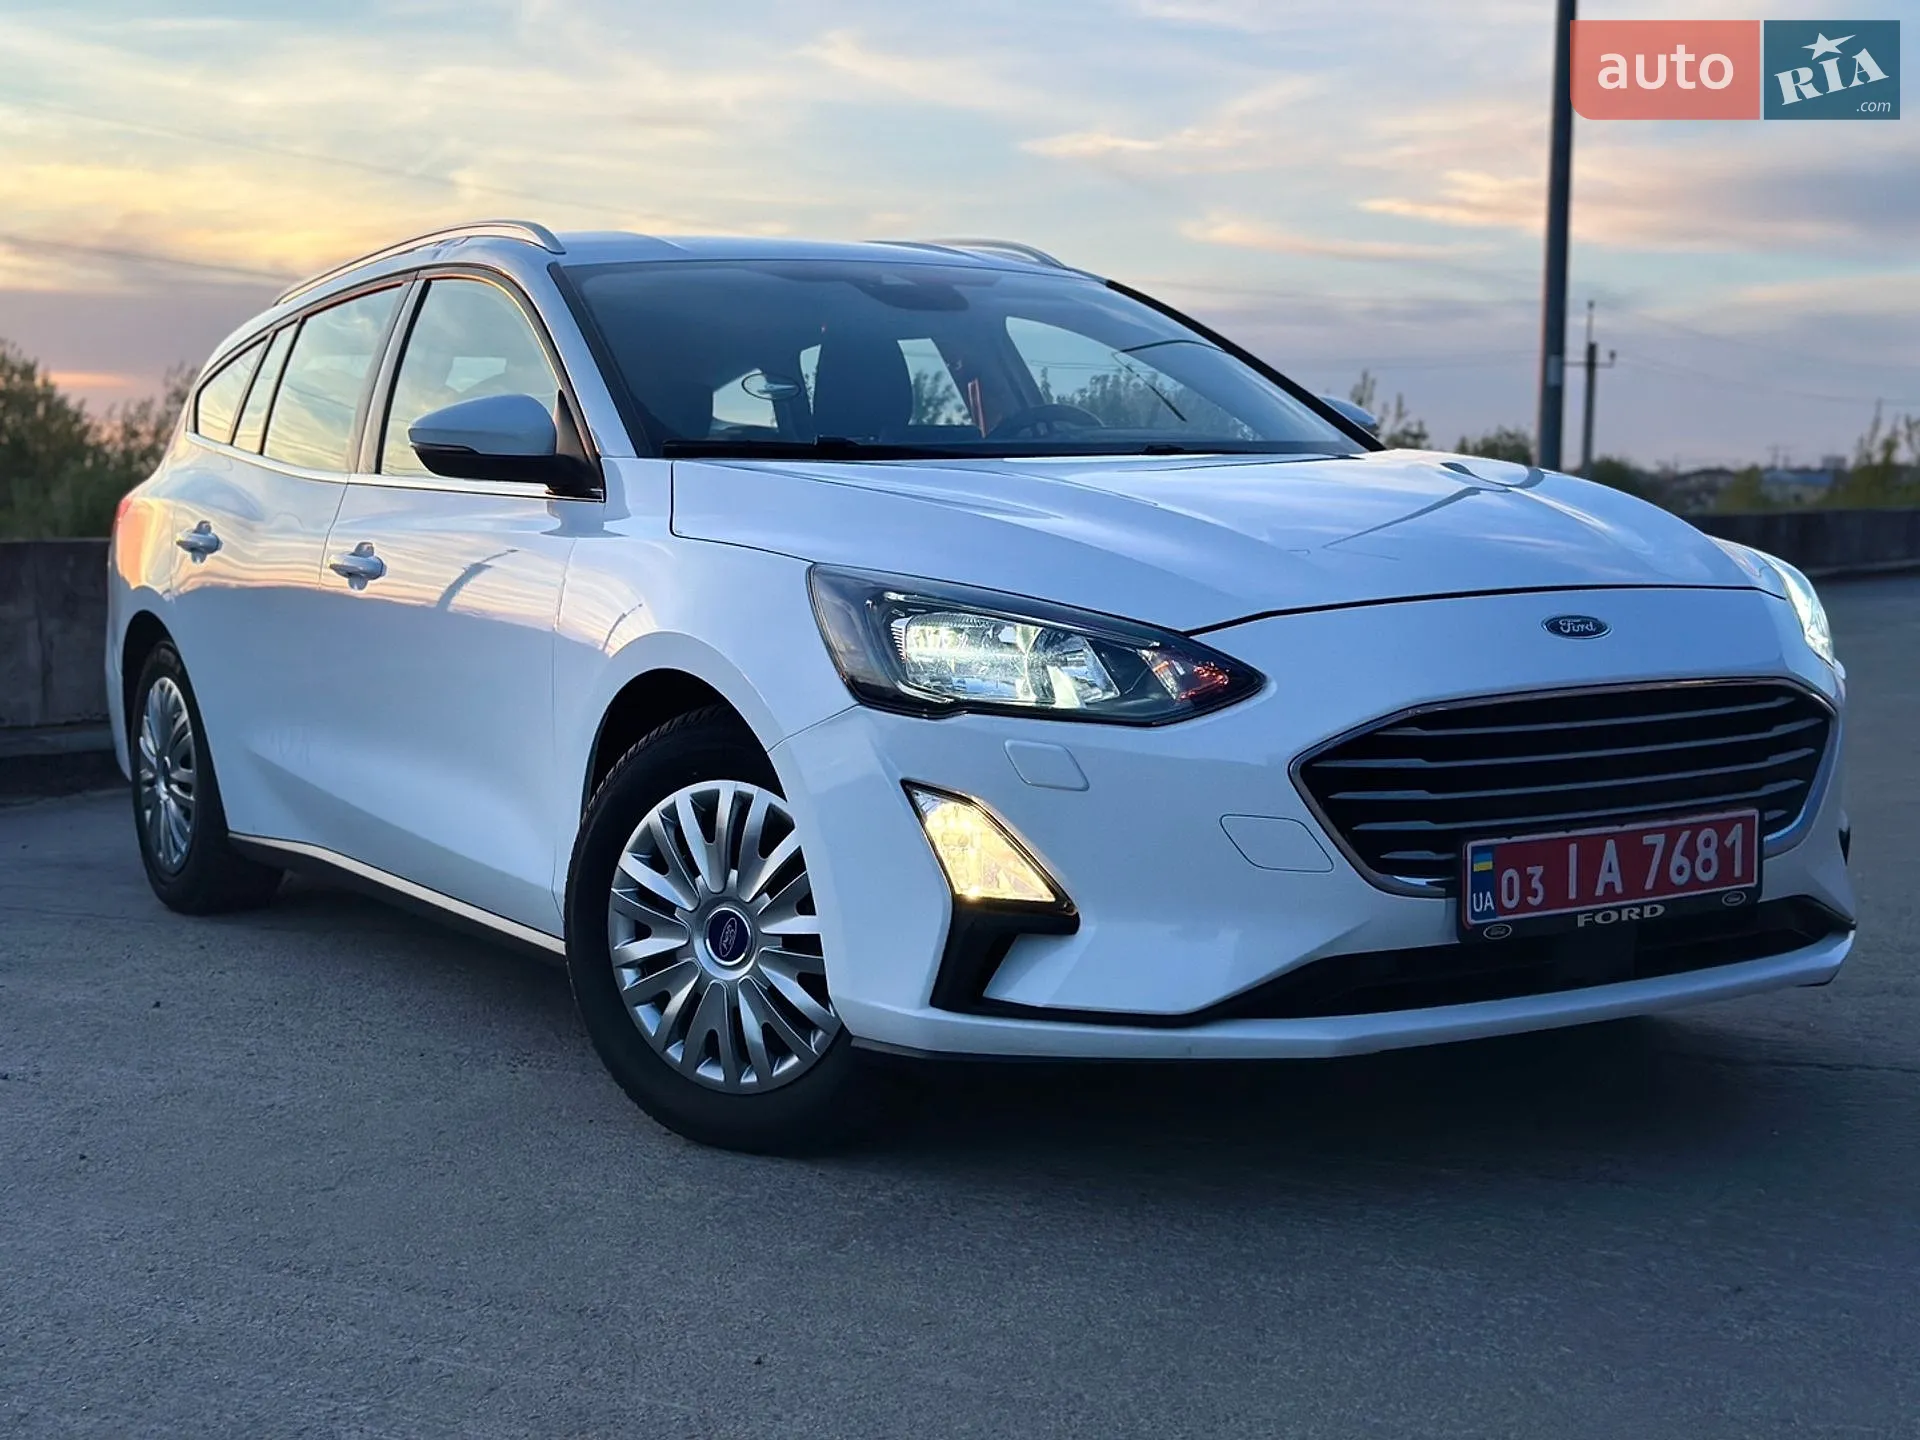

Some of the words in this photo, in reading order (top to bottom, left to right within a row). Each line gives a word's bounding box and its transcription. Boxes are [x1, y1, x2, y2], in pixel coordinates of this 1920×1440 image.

[1559, 619, 1597, 633] Ford
[1501, 865, 1544, 909] 03
[1568, 839, 1623, 899] IA
[1642, 823, 1743, 890] 7681
[1473, 892, 1494, 912] UA
[1577, 903, 1665, 928] FORD
